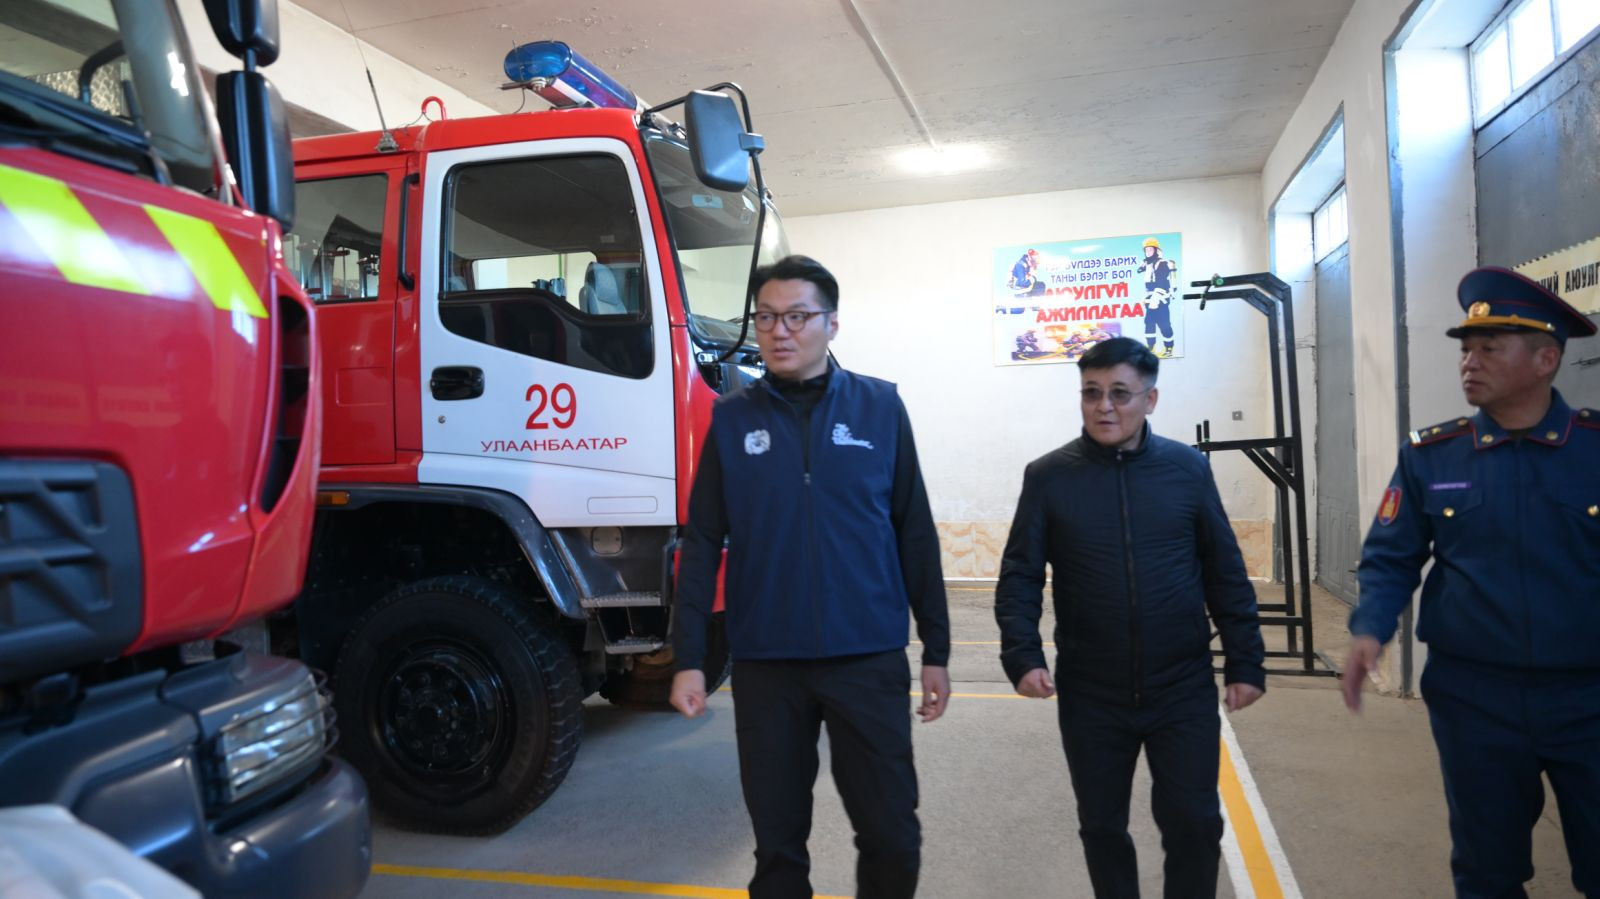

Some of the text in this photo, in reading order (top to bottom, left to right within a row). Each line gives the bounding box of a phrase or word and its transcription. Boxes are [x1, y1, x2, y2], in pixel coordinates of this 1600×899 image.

[1104, 256, 1137, 268] БАРИХ
[1051, 269, 1132, 284] ТАНЫ БЭЛЭГ БОЛ
[1036, 302, 1144, 323] АЖИЛЛАГАА
[525, 382, 577, 430] 29
[480, 437, 628, 453] УЛААНБААТАР
